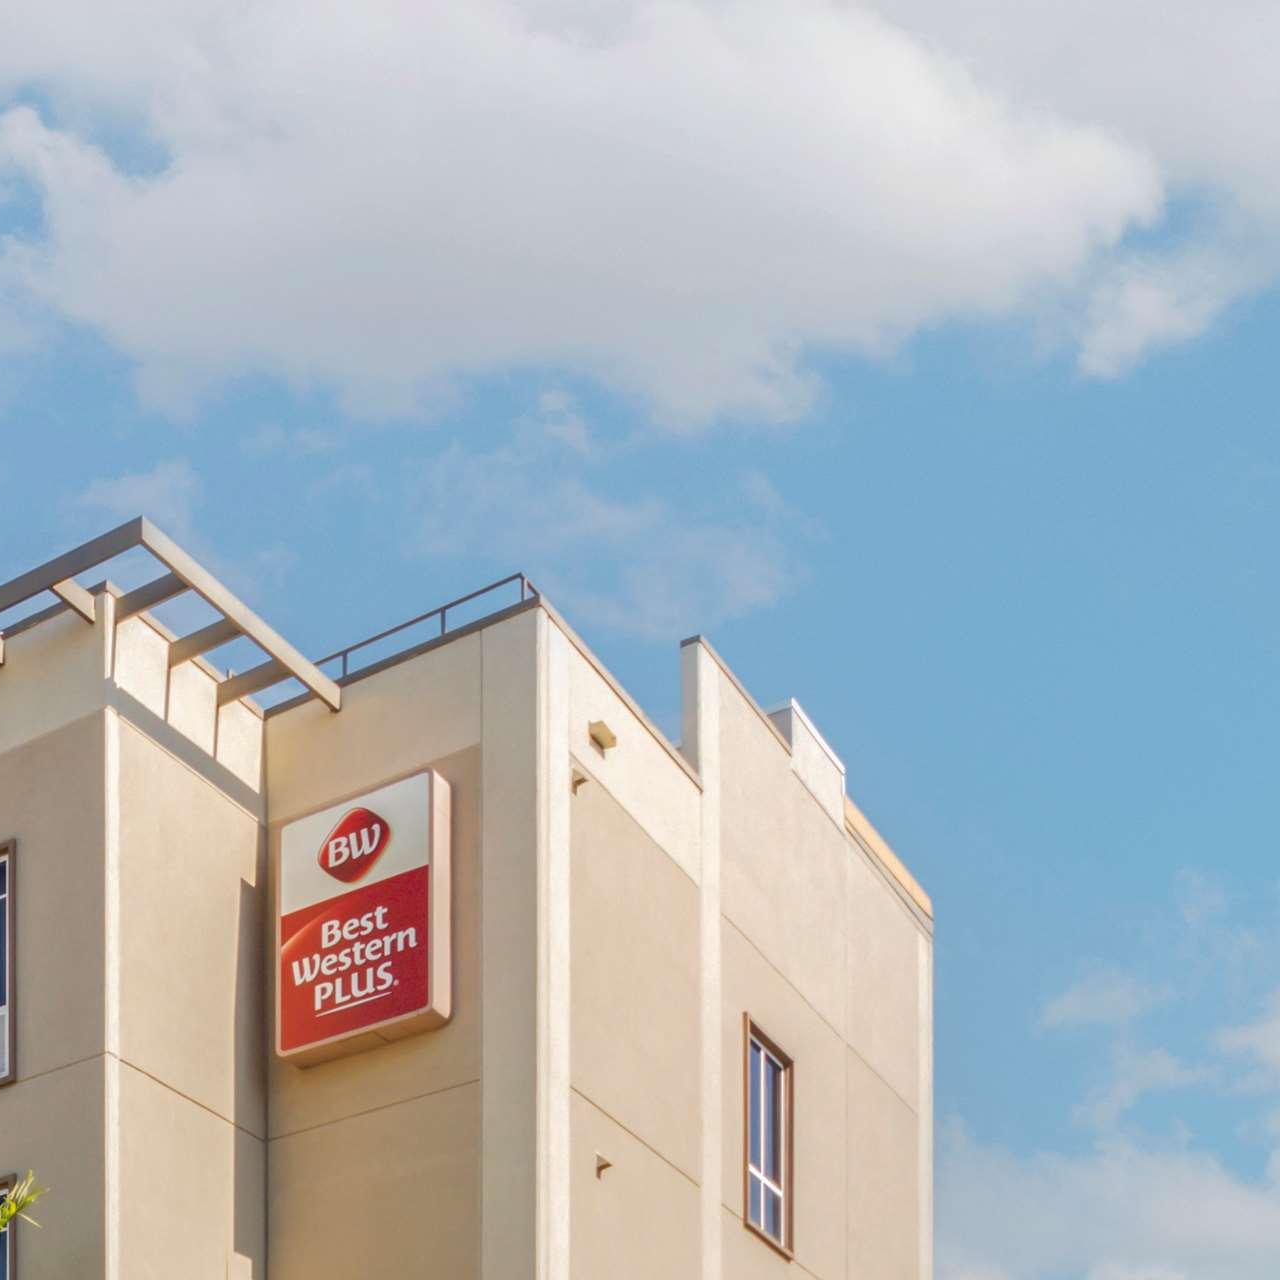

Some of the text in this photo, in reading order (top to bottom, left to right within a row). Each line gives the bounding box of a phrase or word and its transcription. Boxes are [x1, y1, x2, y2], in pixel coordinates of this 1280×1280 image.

[328, 824, 381, 868] BW
[321, 906, 388, 949] Best
[292, 927, 417, 986] Western
